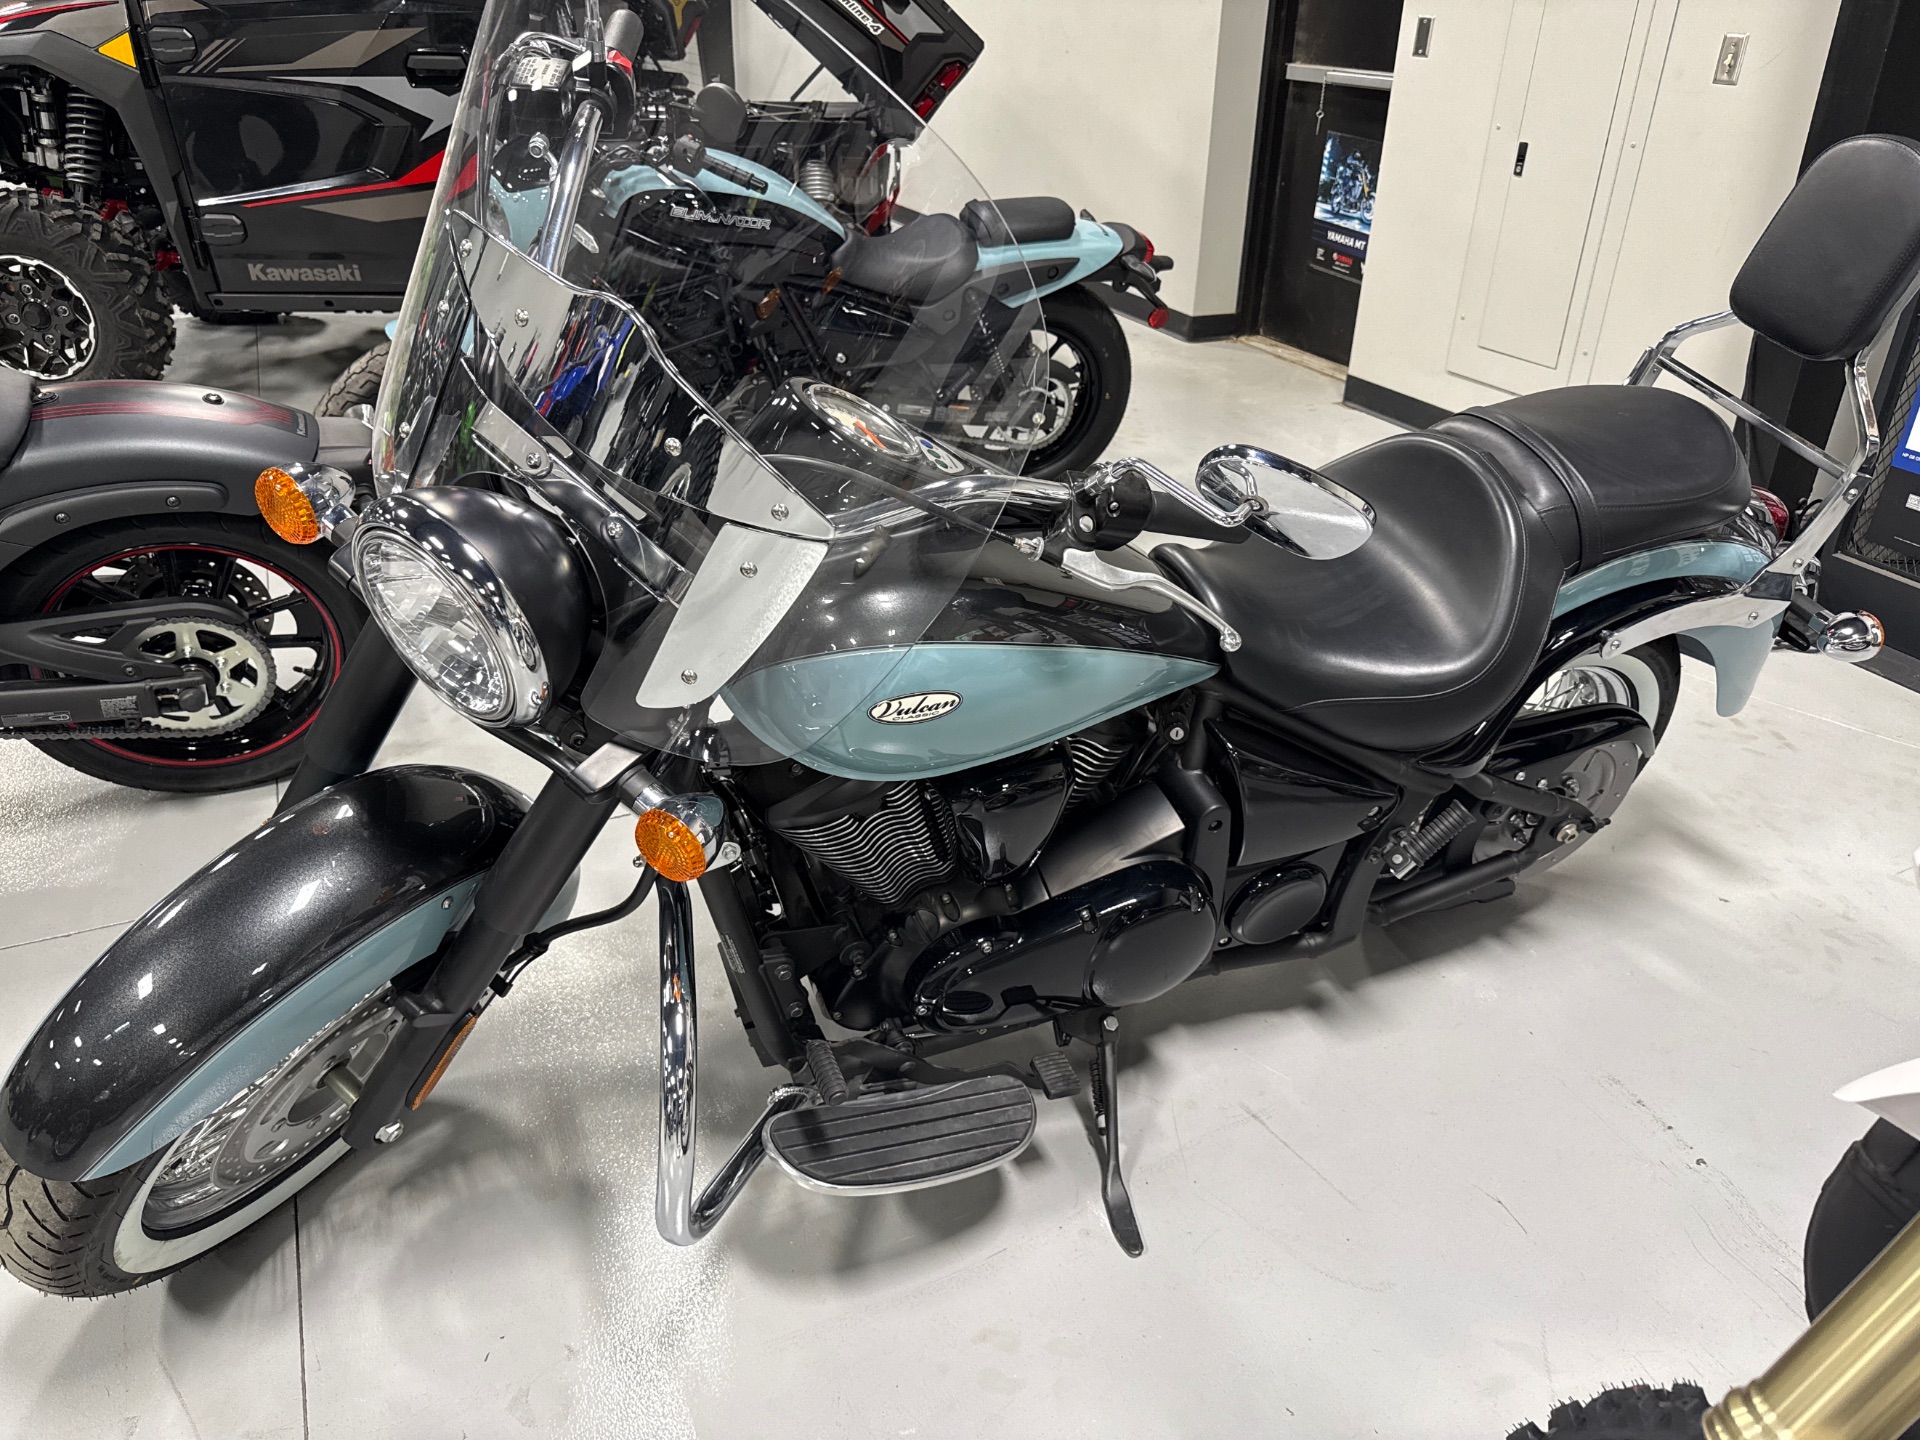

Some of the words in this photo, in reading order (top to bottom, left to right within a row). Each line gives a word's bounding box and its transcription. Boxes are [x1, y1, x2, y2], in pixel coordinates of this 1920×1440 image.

[1327, 230, 1354, 248] YAMAHA
[1354, 239, 1366, 251] MT
[247, 263, 362, 281] Kawasaki
[877, 696, 956, 718] Vulcan
[892, 711, 940, 721] CLASSIC
